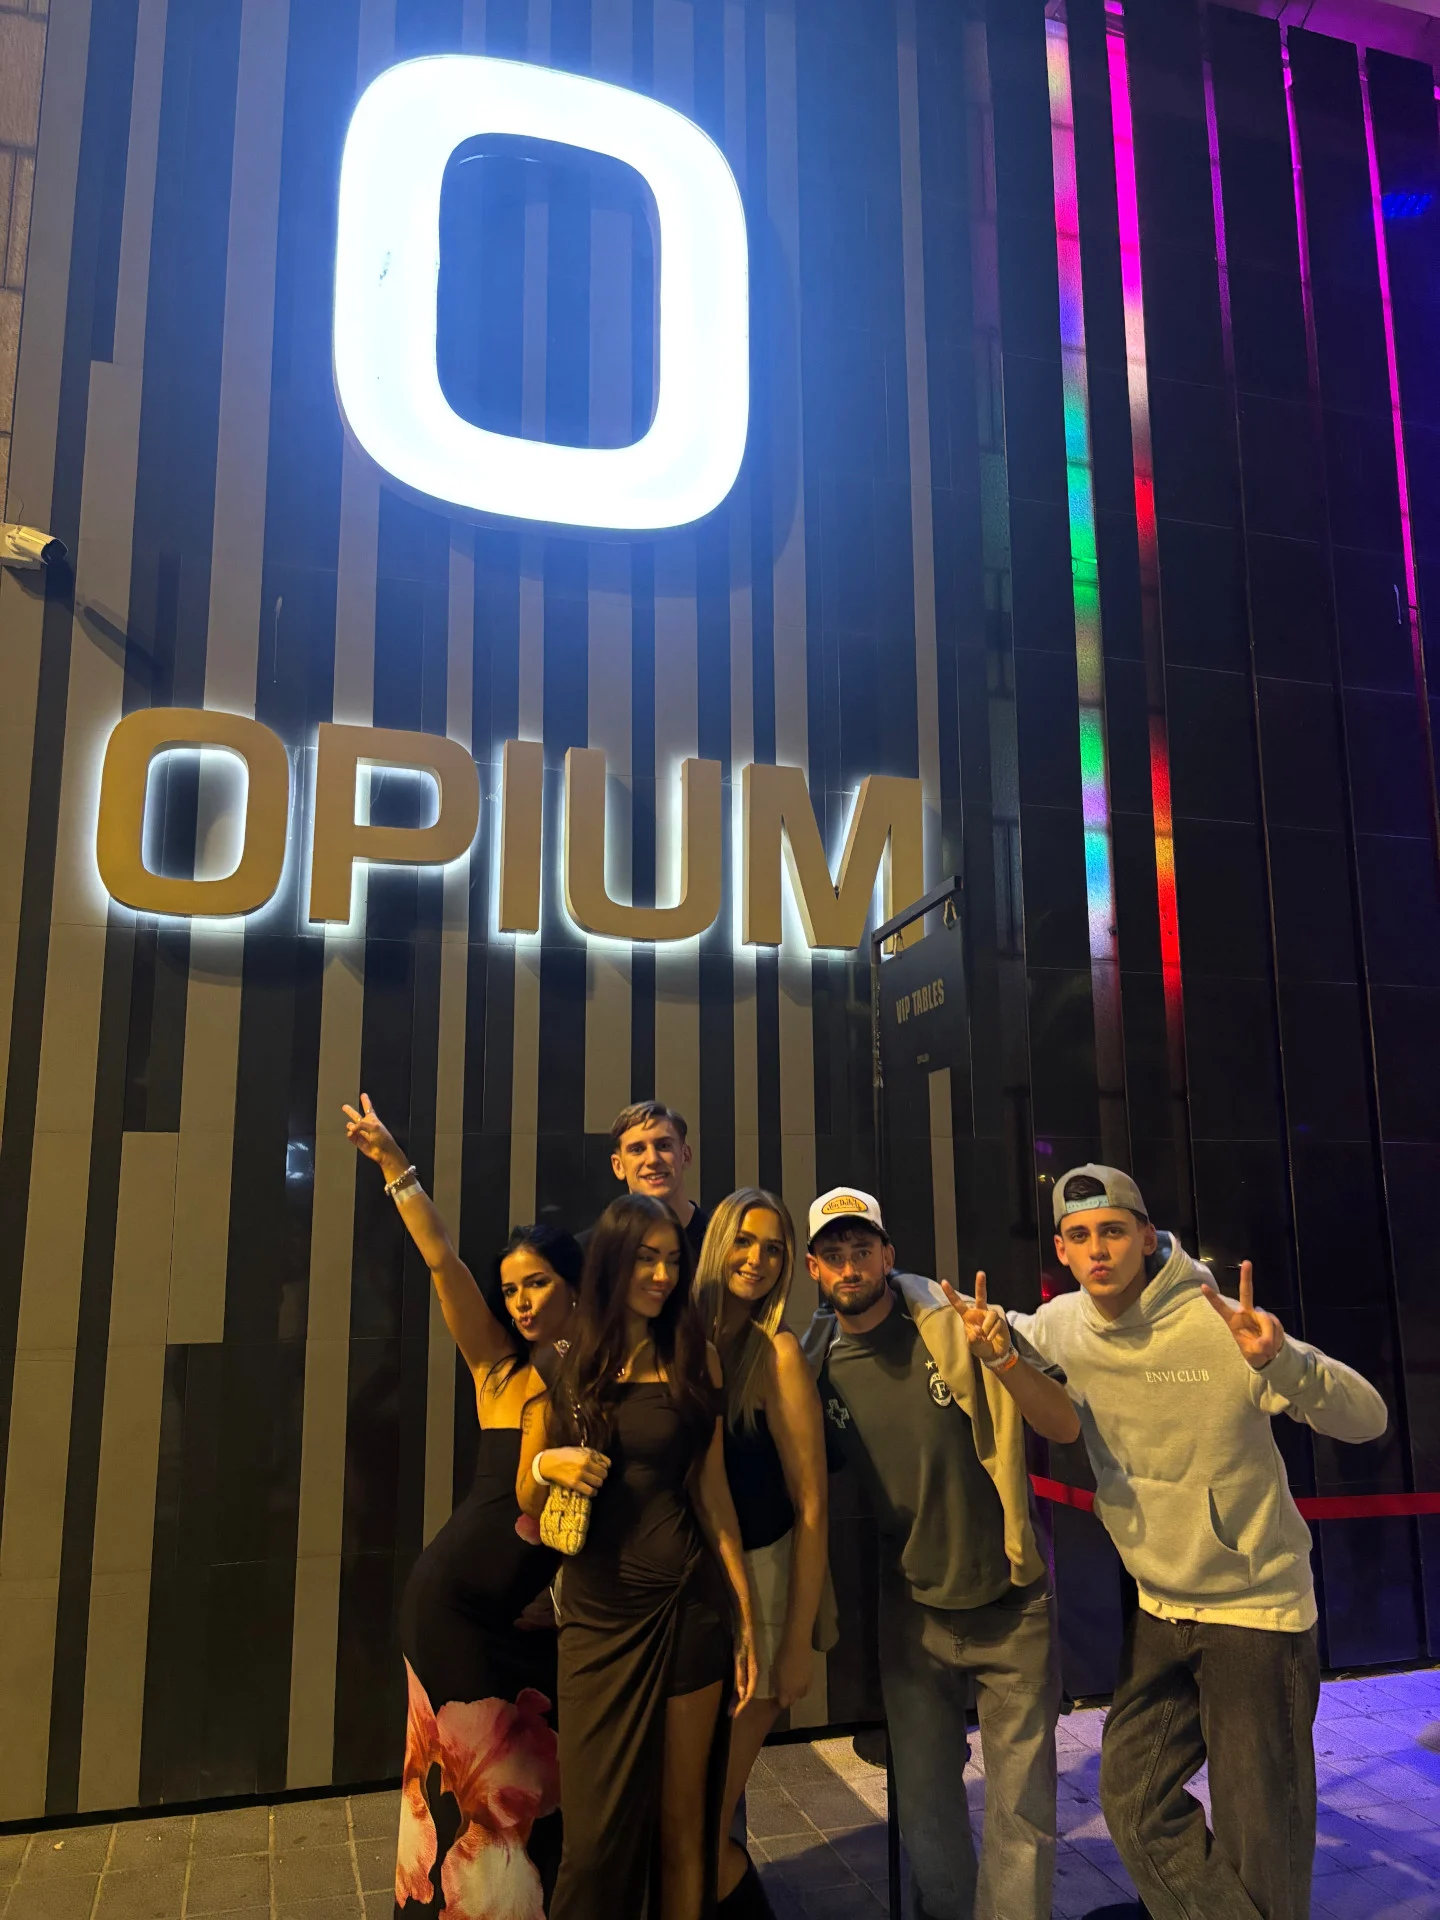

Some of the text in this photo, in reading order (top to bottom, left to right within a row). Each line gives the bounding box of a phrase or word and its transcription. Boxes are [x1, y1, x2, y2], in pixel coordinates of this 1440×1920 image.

[333, 53, 750, 530] O
[97, 707, 924, 952] OPIUM
[895, 977, 945, 1024] VIP TABLES
[1145, 1368, 1210, 1383] ENVI CLUB
